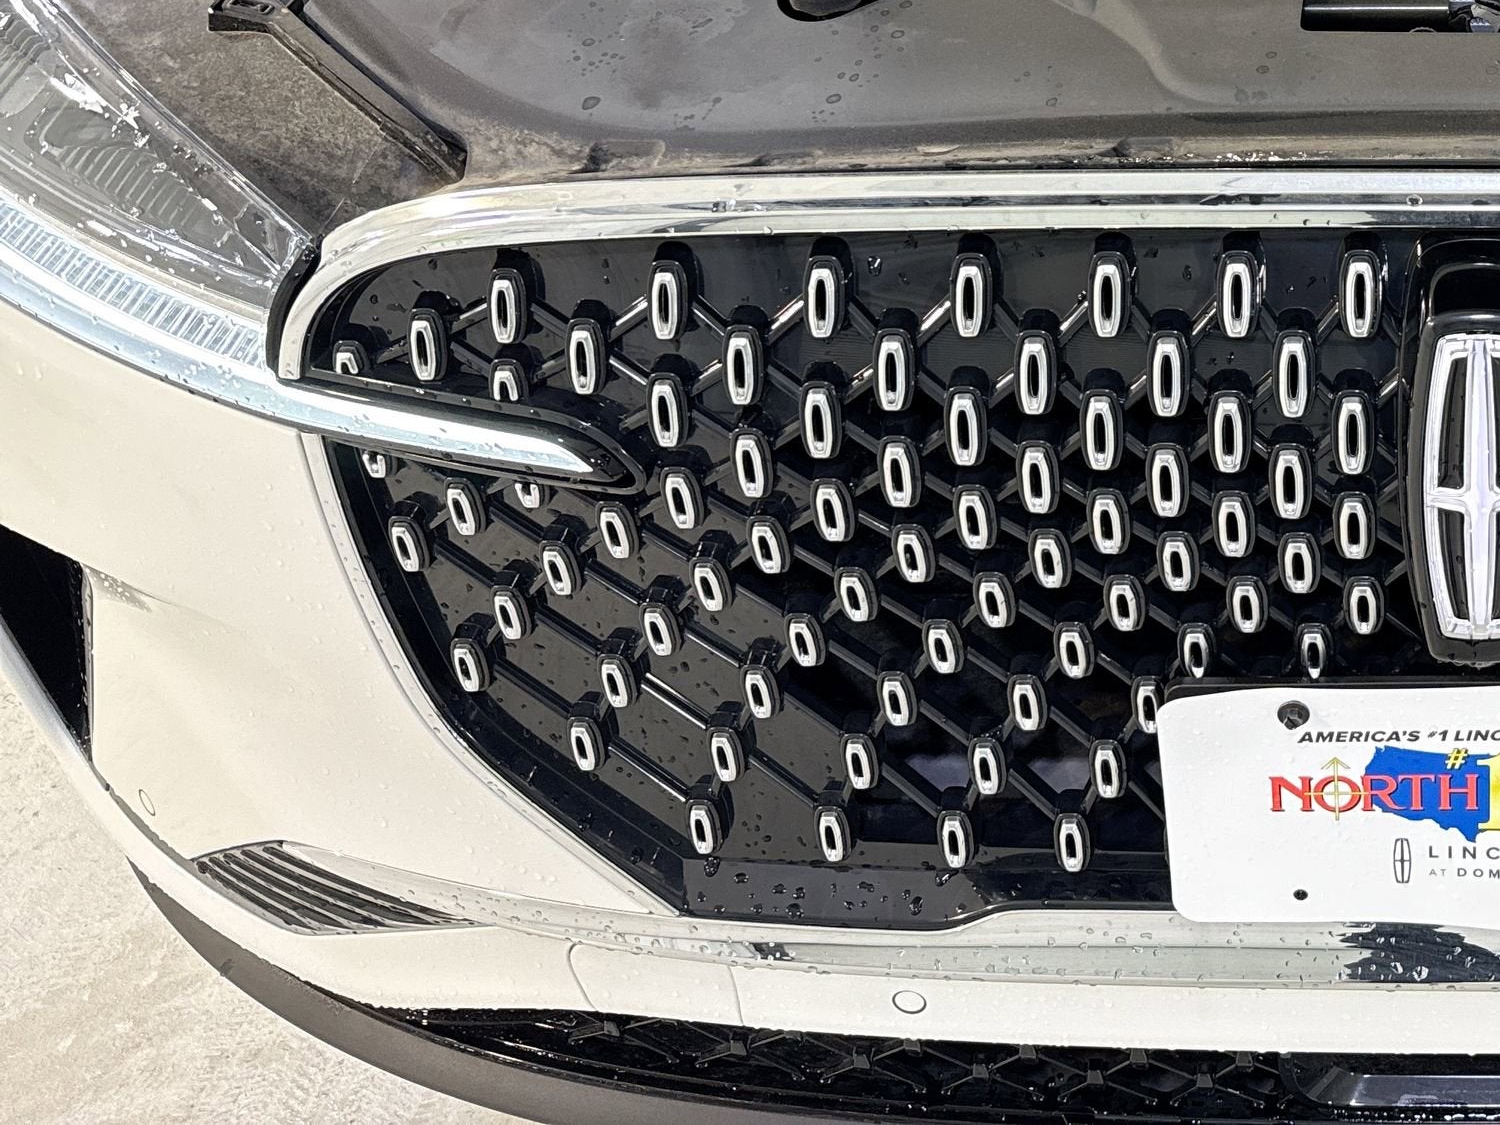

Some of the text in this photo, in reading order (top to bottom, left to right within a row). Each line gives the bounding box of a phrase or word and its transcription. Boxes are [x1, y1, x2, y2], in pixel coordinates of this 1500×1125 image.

[1427, 730, 1448, 742] #1
[1268, 774, 1483, 813] NORTH
[1428, 868, 1447, 877] AT
